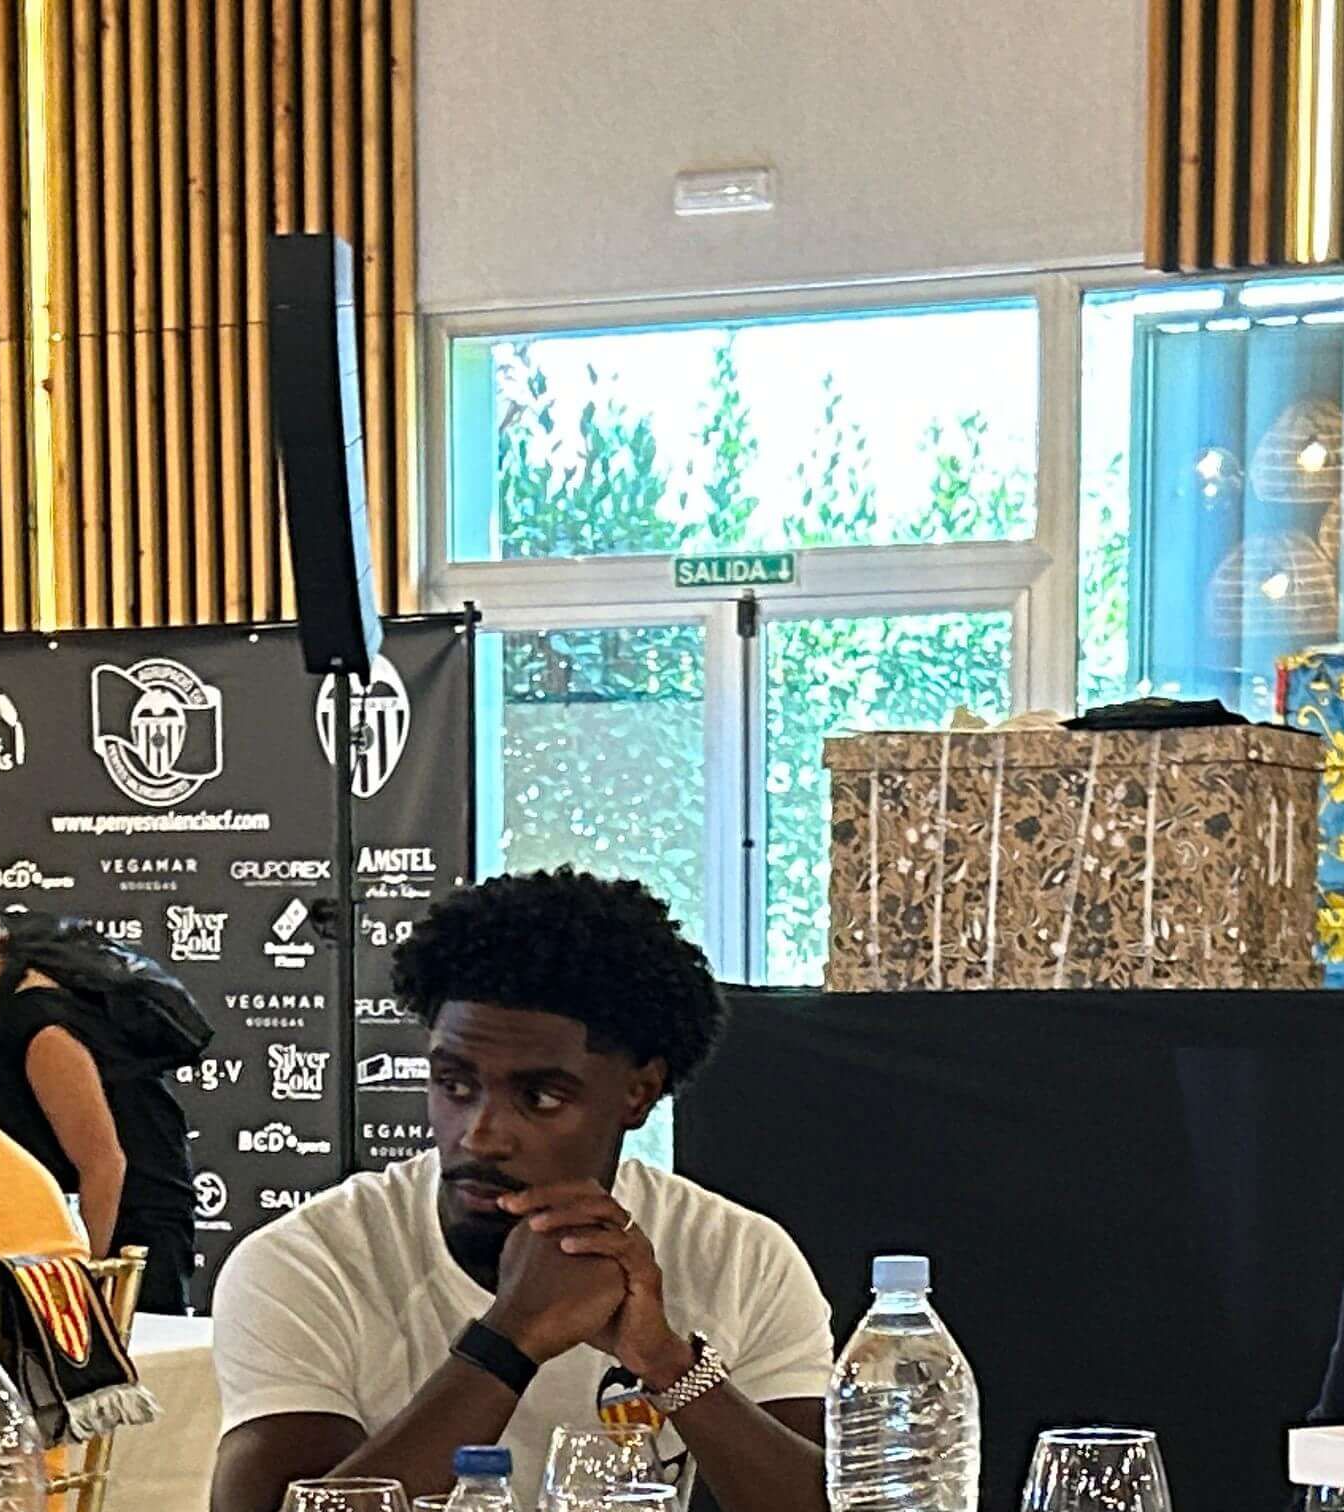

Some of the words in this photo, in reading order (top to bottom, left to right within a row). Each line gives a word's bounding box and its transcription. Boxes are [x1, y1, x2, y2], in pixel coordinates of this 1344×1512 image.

[678, 559, 768, 584] SALIDA
[51, 810, 271, 835] www.penyesvalenciacf.com
[100, 858, 198, 874] VEGAMAR
[357, 847, 436, 872] AMSTEL
[225, 994, 326, 1010] VEGAMAR
[363, 1123, 434, 1139] EGAMA
